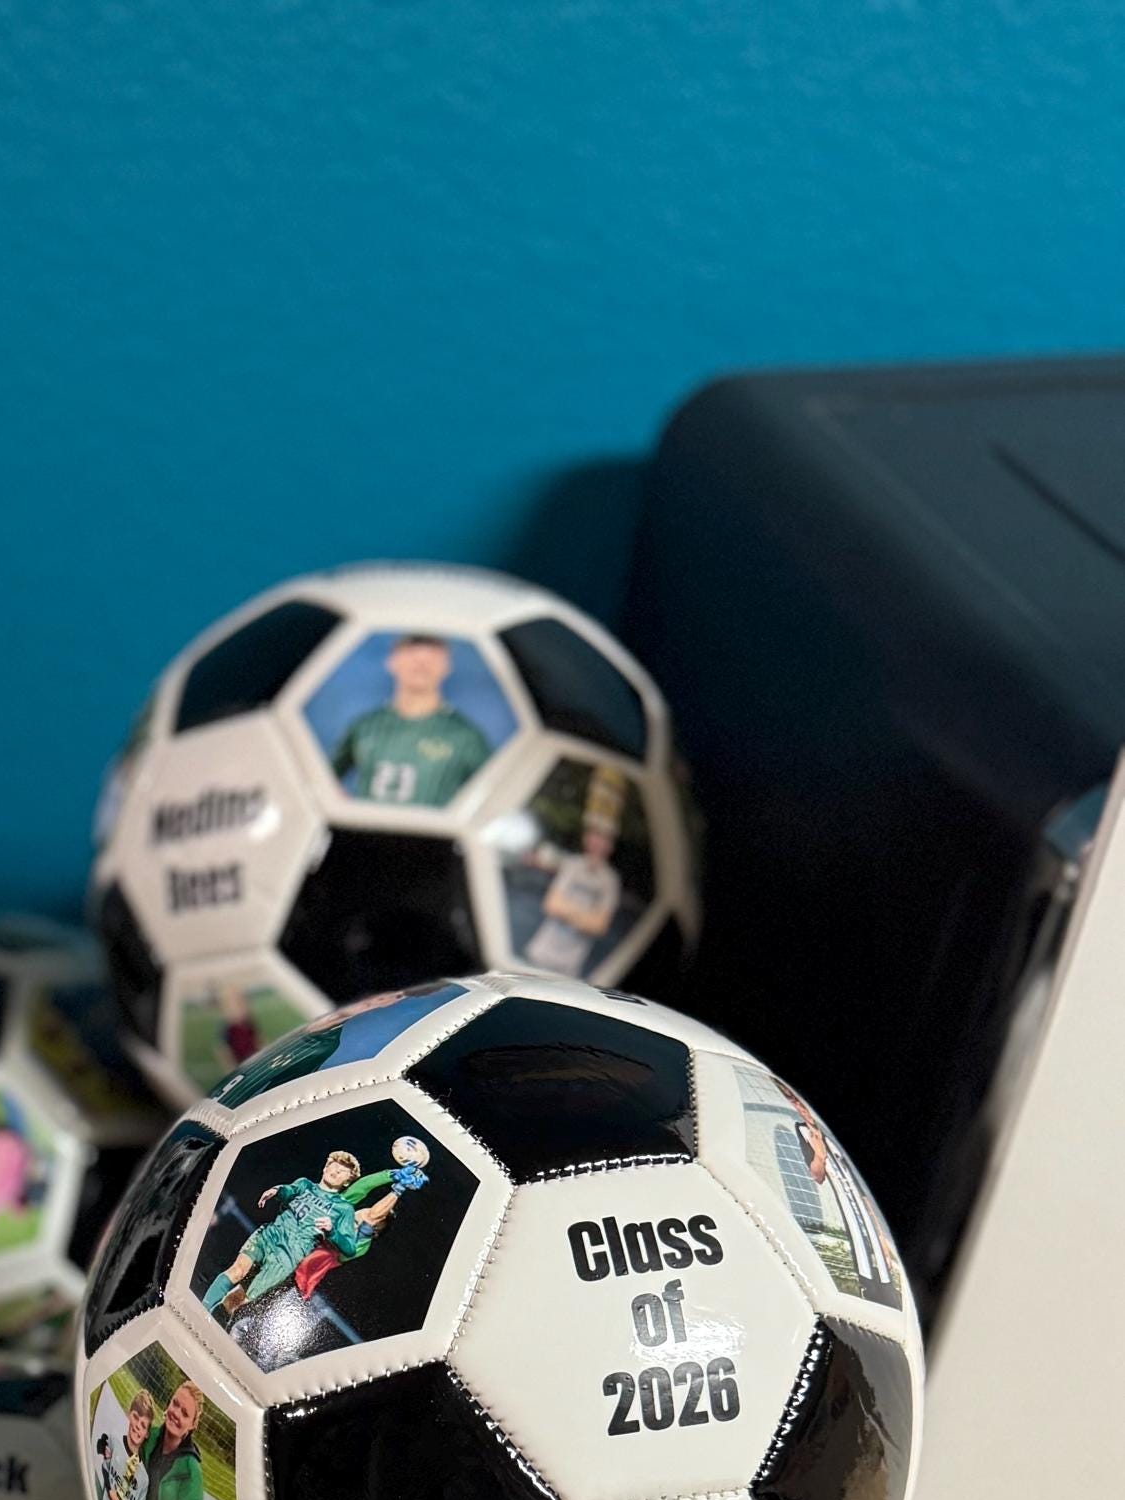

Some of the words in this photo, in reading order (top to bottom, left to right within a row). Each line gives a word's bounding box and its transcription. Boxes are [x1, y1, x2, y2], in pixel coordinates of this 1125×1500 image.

[567, 1214, 724, 1282] Class
[633, 1279, 685, 1347] of
[602, 1357, 741, 1437] 2026
